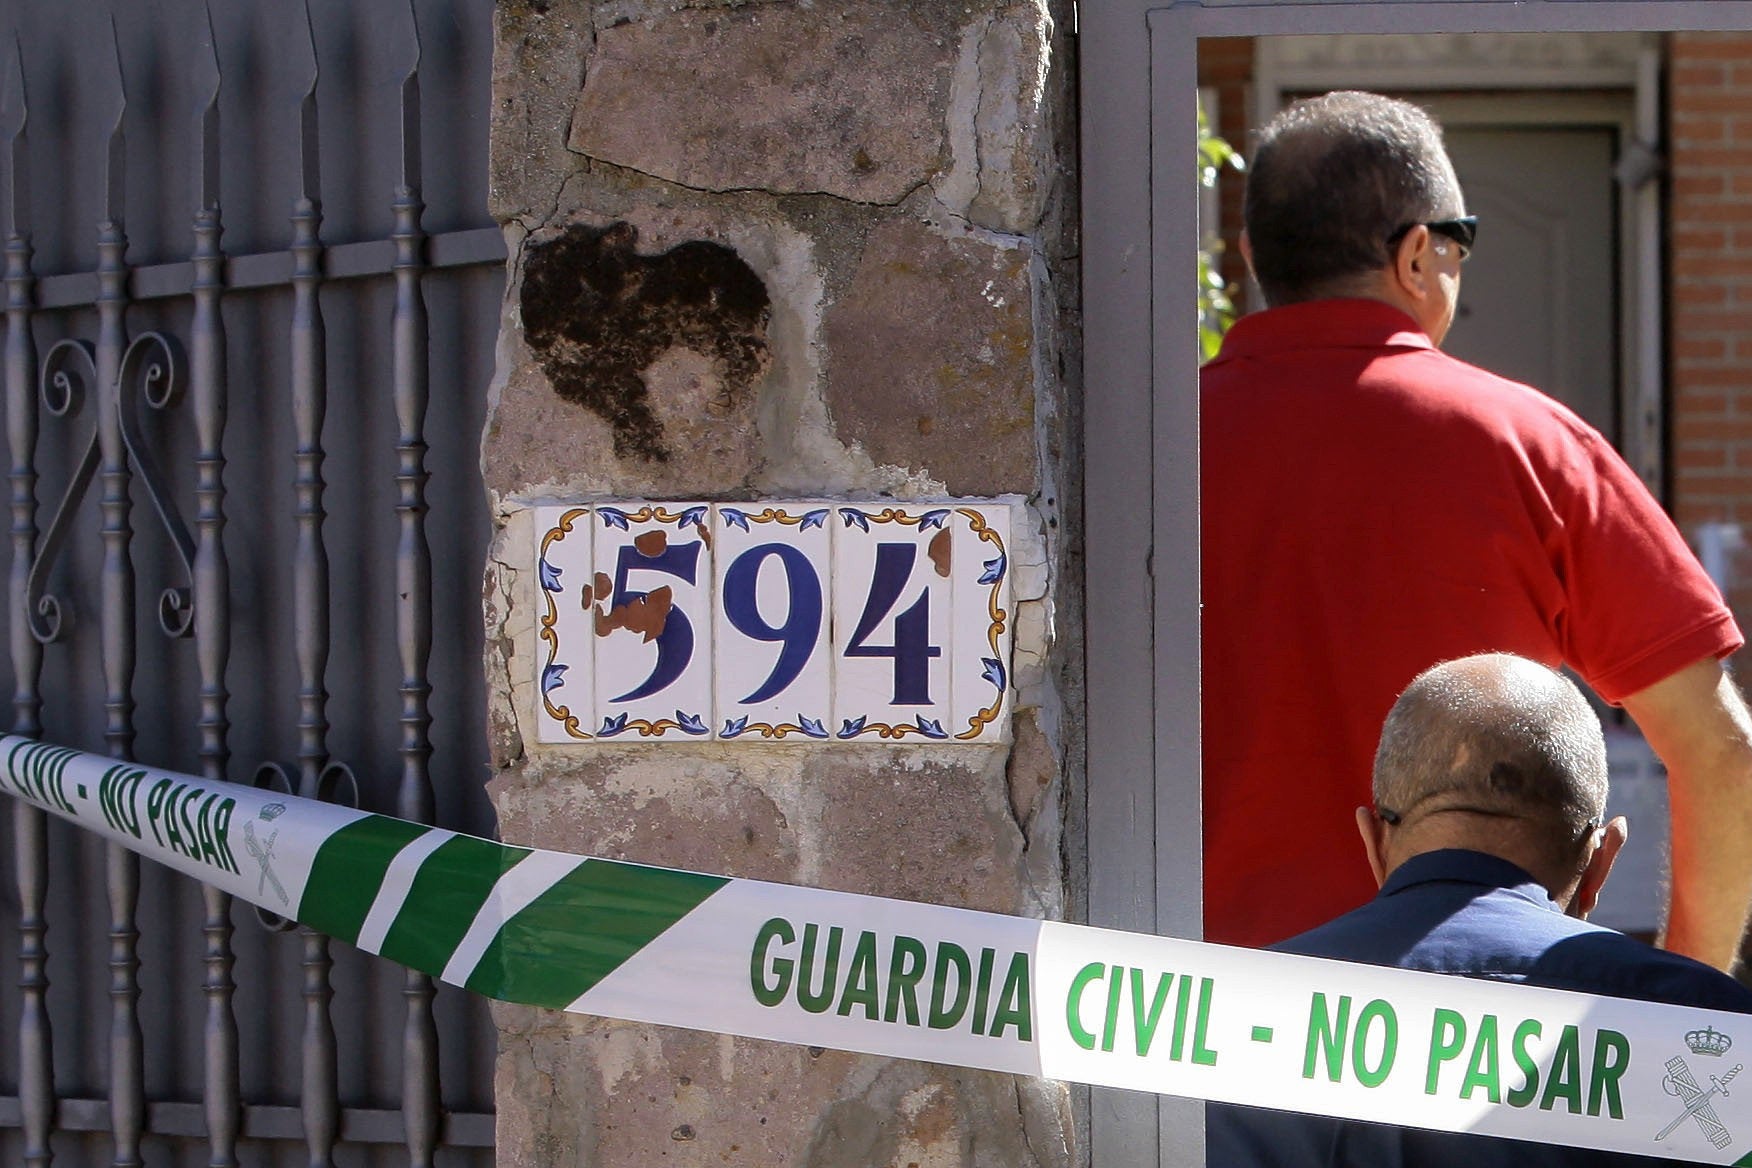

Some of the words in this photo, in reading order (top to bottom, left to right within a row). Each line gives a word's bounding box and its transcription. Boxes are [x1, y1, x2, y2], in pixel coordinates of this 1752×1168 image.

[608, 540, 942, 706] 594
[99, 764, 148, 840] NO
[147, 777, 242, 876] PASAR
[750, 917, 1033, 1042] GUARDIA
[1066, 961, 1218, 1067] CIVIL
[1302, 991, 1399, 1089] NO
[1425, 1007, 1631, 1120] PASAR
